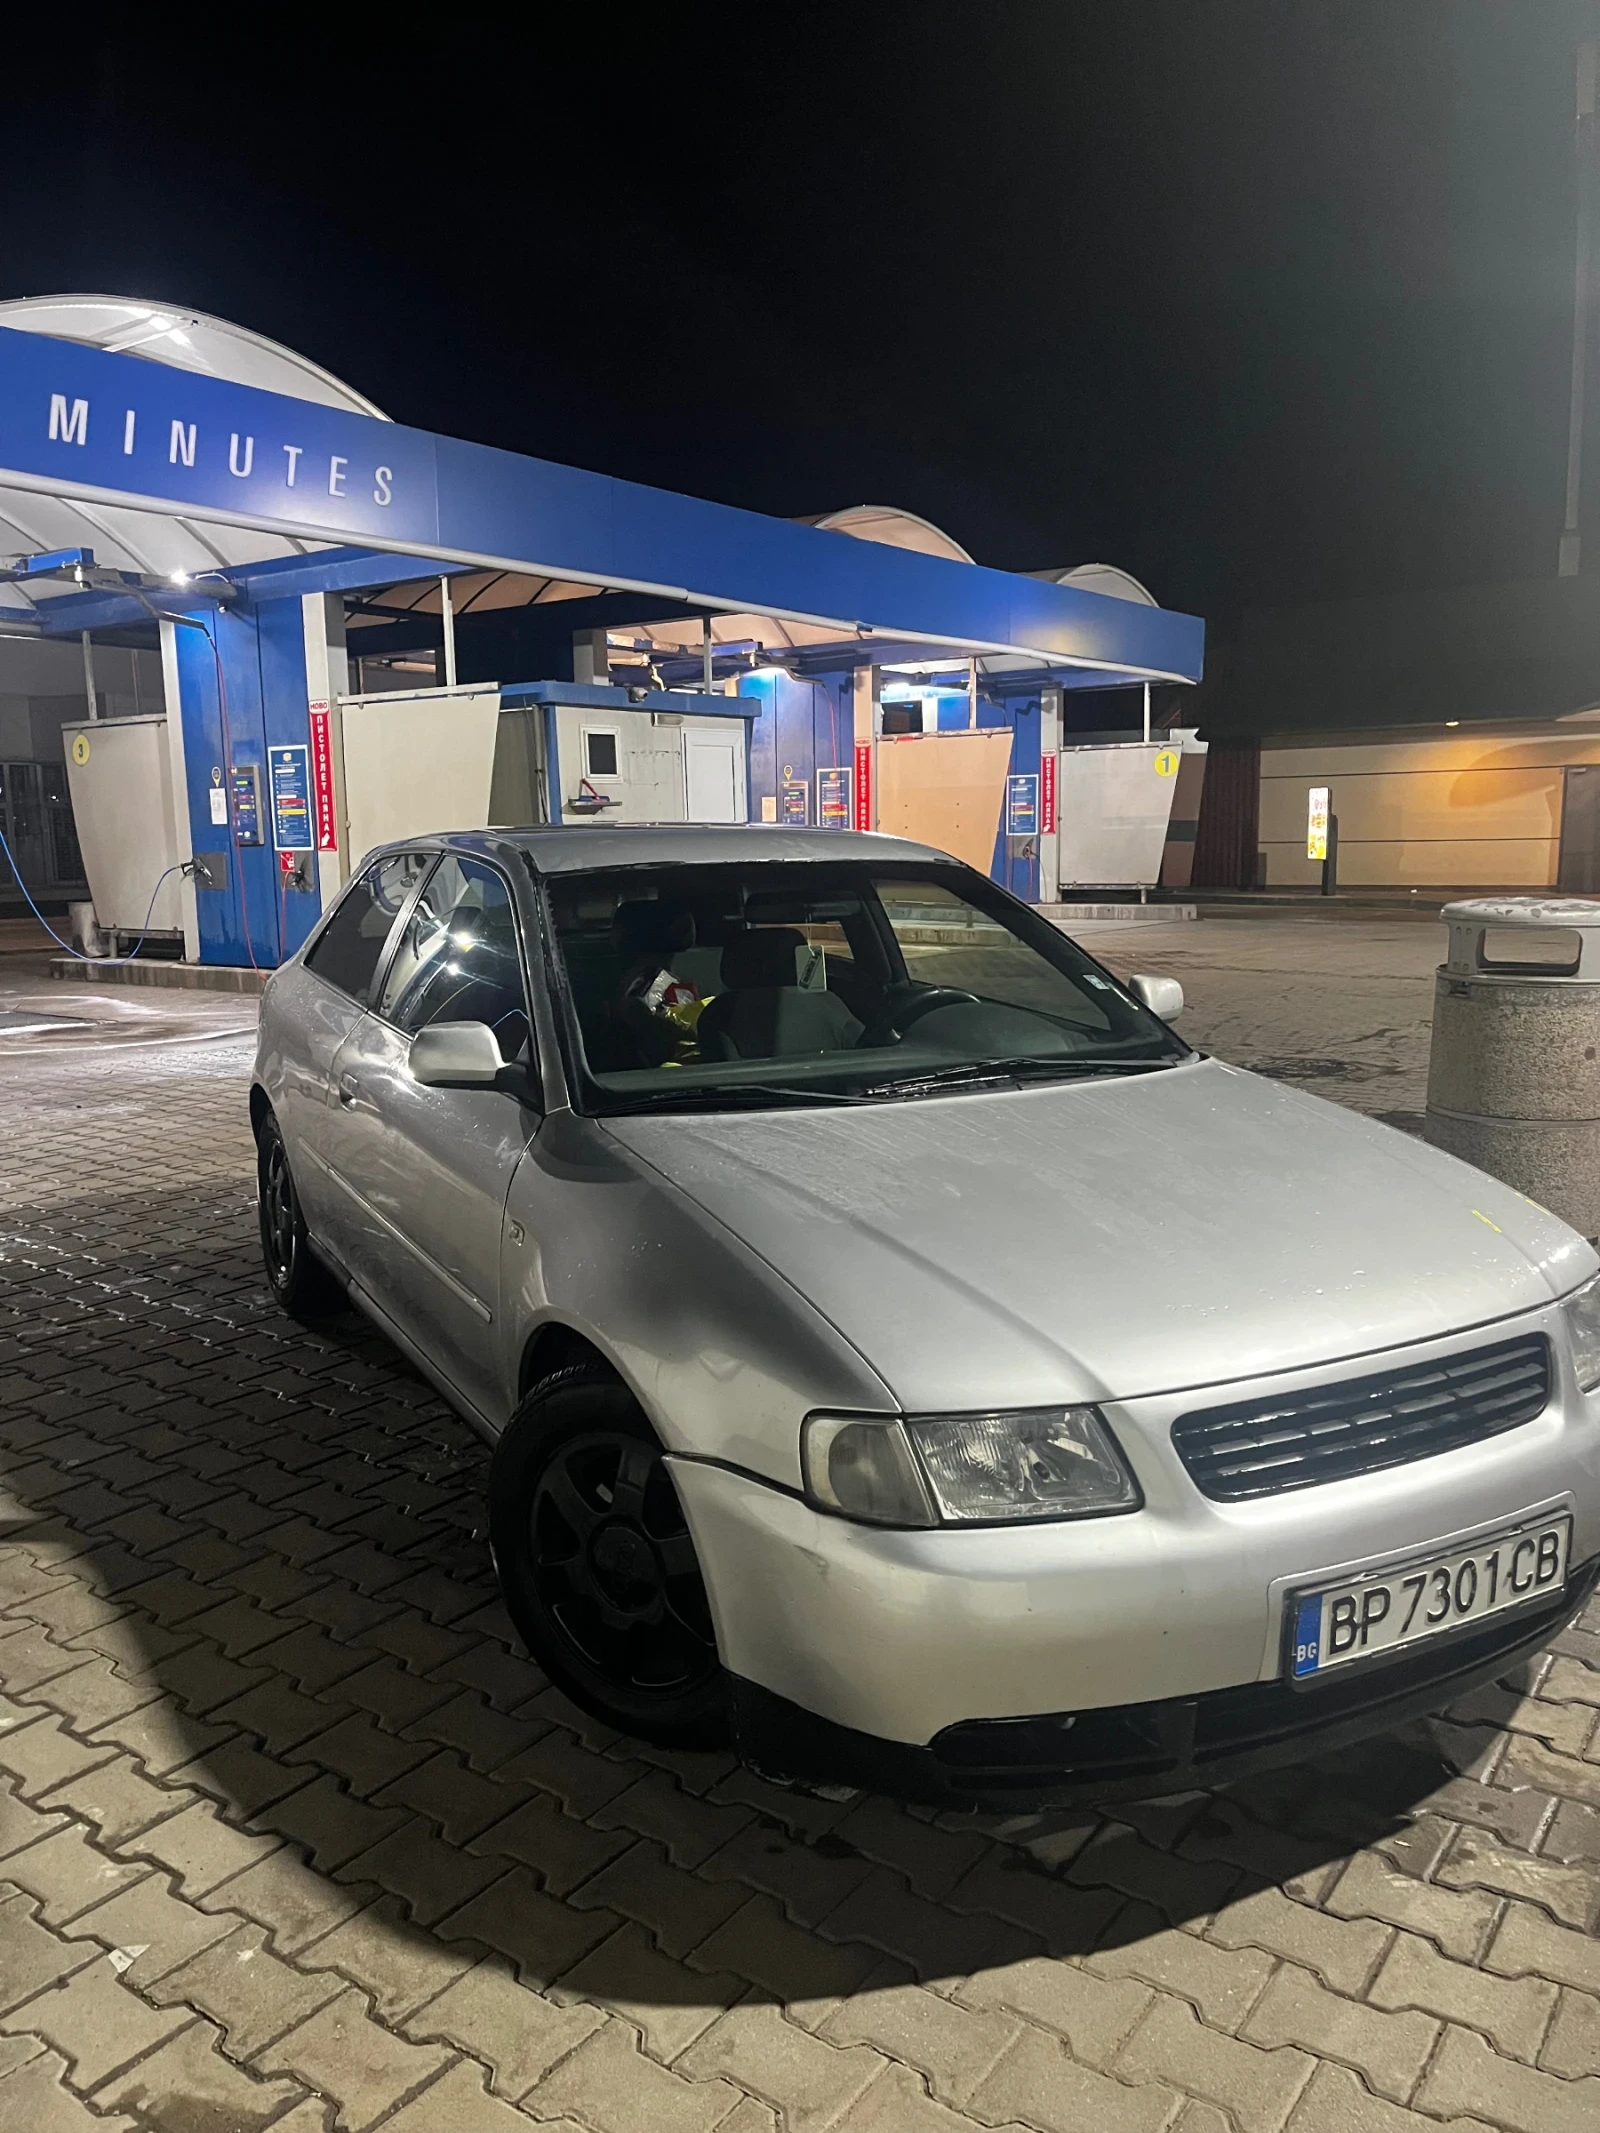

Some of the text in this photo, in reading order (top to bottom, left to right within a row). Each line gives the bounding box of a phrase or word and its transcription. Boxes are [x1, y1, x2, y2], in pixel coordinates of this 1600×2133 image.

[48, 393, 393, 507] MINUTES
[310, 702, 327, 710] НОВО
[78, 743, 83, 758] 3
[316, 715, 331, 832] ПИСТОЛЕТ ПЯНА
[1161, 755, 1170, 773] 1
[1329, 1529, 1559, 1654] BP 7301 CB
[1296, 1641, 1317, 1663] BG
